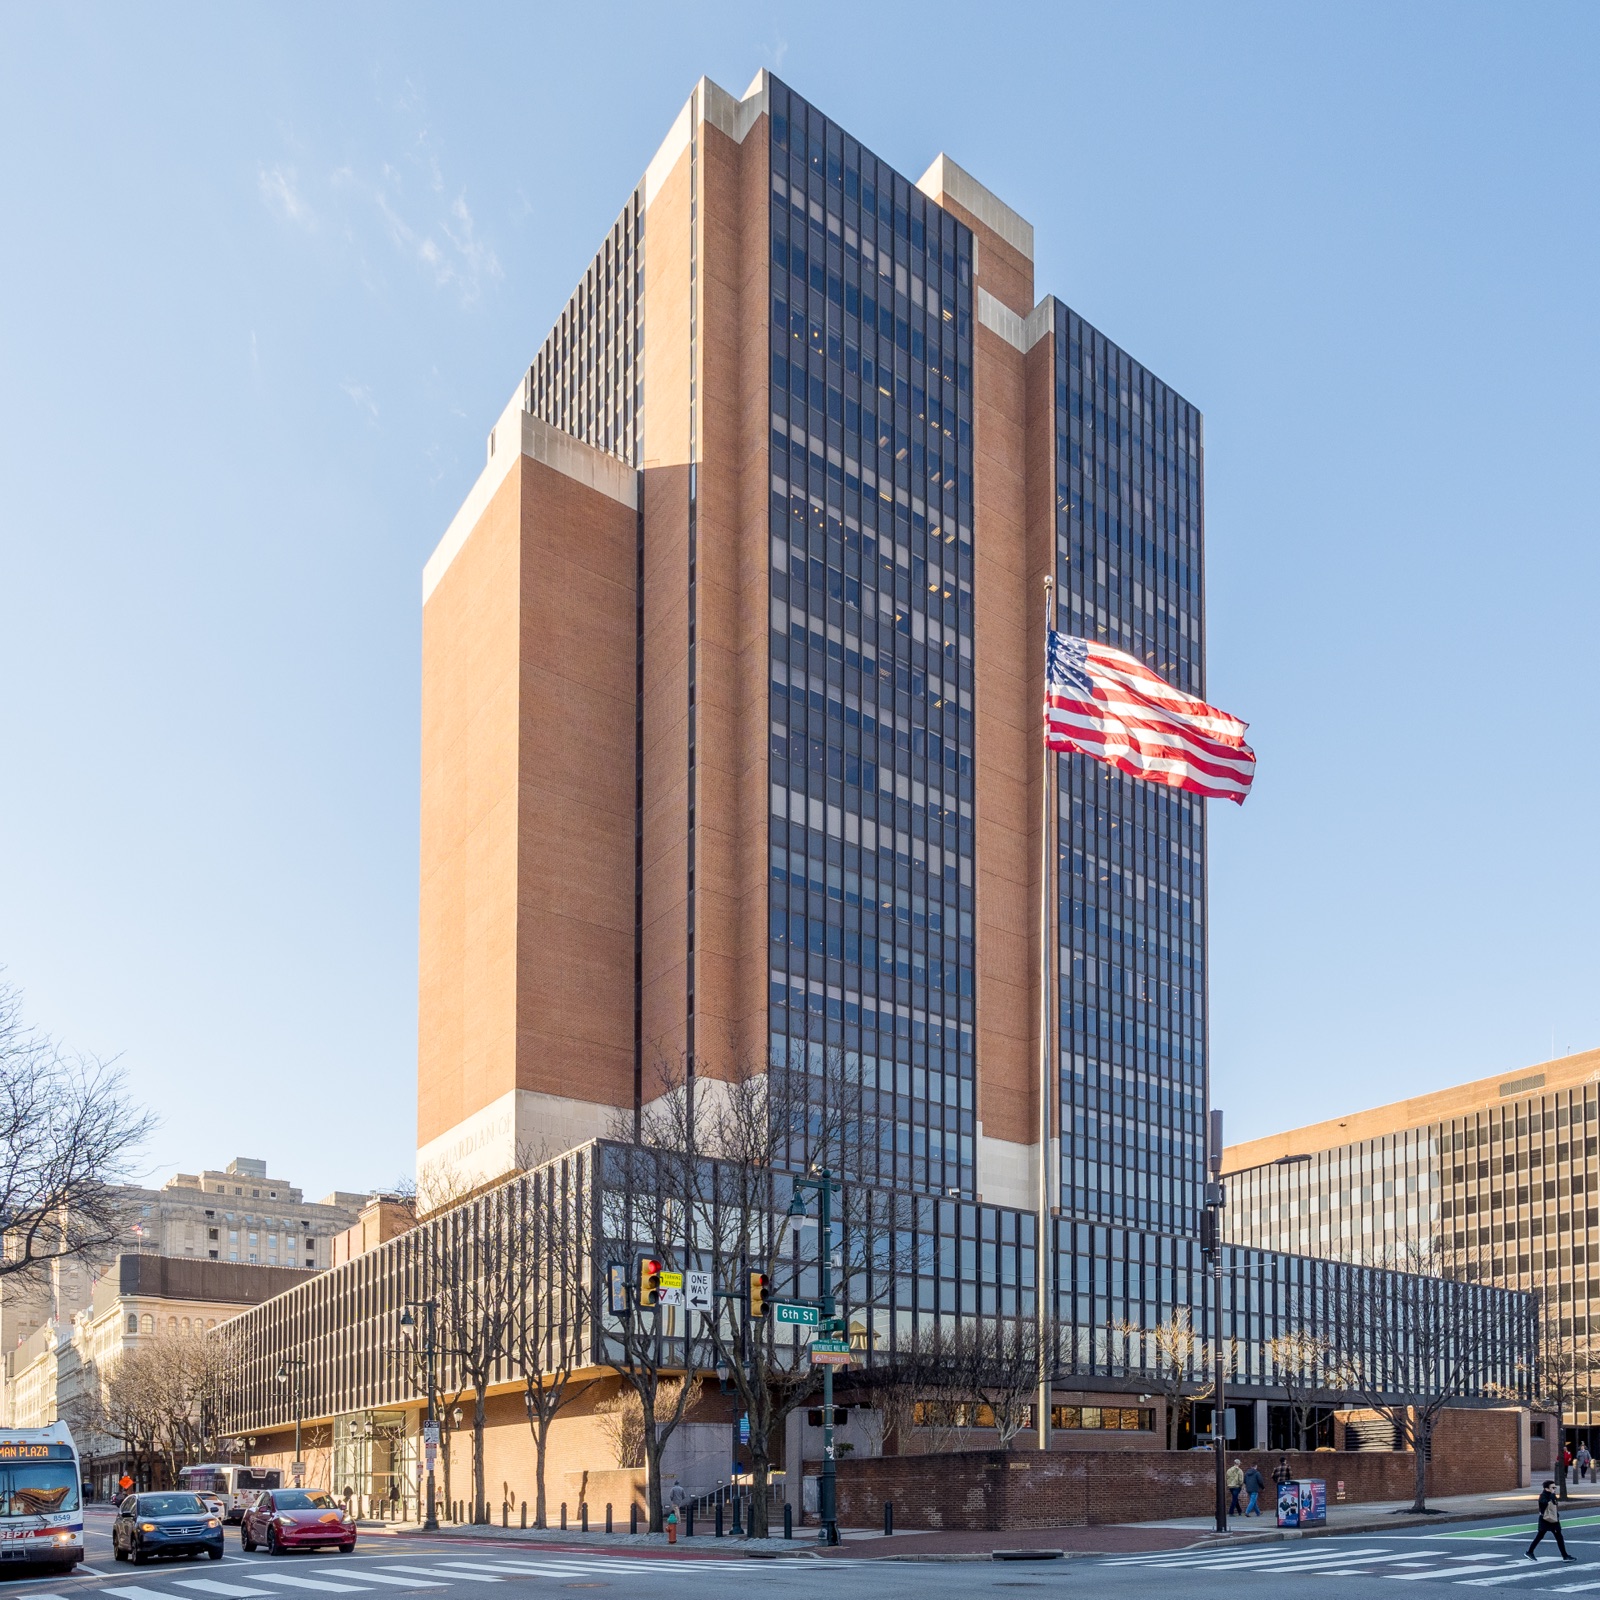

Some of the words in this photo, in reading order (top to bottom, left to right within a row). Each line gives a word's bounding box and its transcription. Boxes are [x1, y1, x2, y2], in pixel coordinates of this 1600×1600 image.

[440, 1121, 495, 1171] GUARDIAN
[499, 1111, 512, 1136] OF
[691, 1274, 708, 1285] ONE
[690, 1285, 708, 1295] WAY
[782, 1308, 799, 1320] 6th
[803, 1311, 814, 1321] St
[19, 1446, 49, 1457] PLAZA
[53, 1514, 71, 1522] 8549
[0, 1530, 36, 1539] SEPTA
